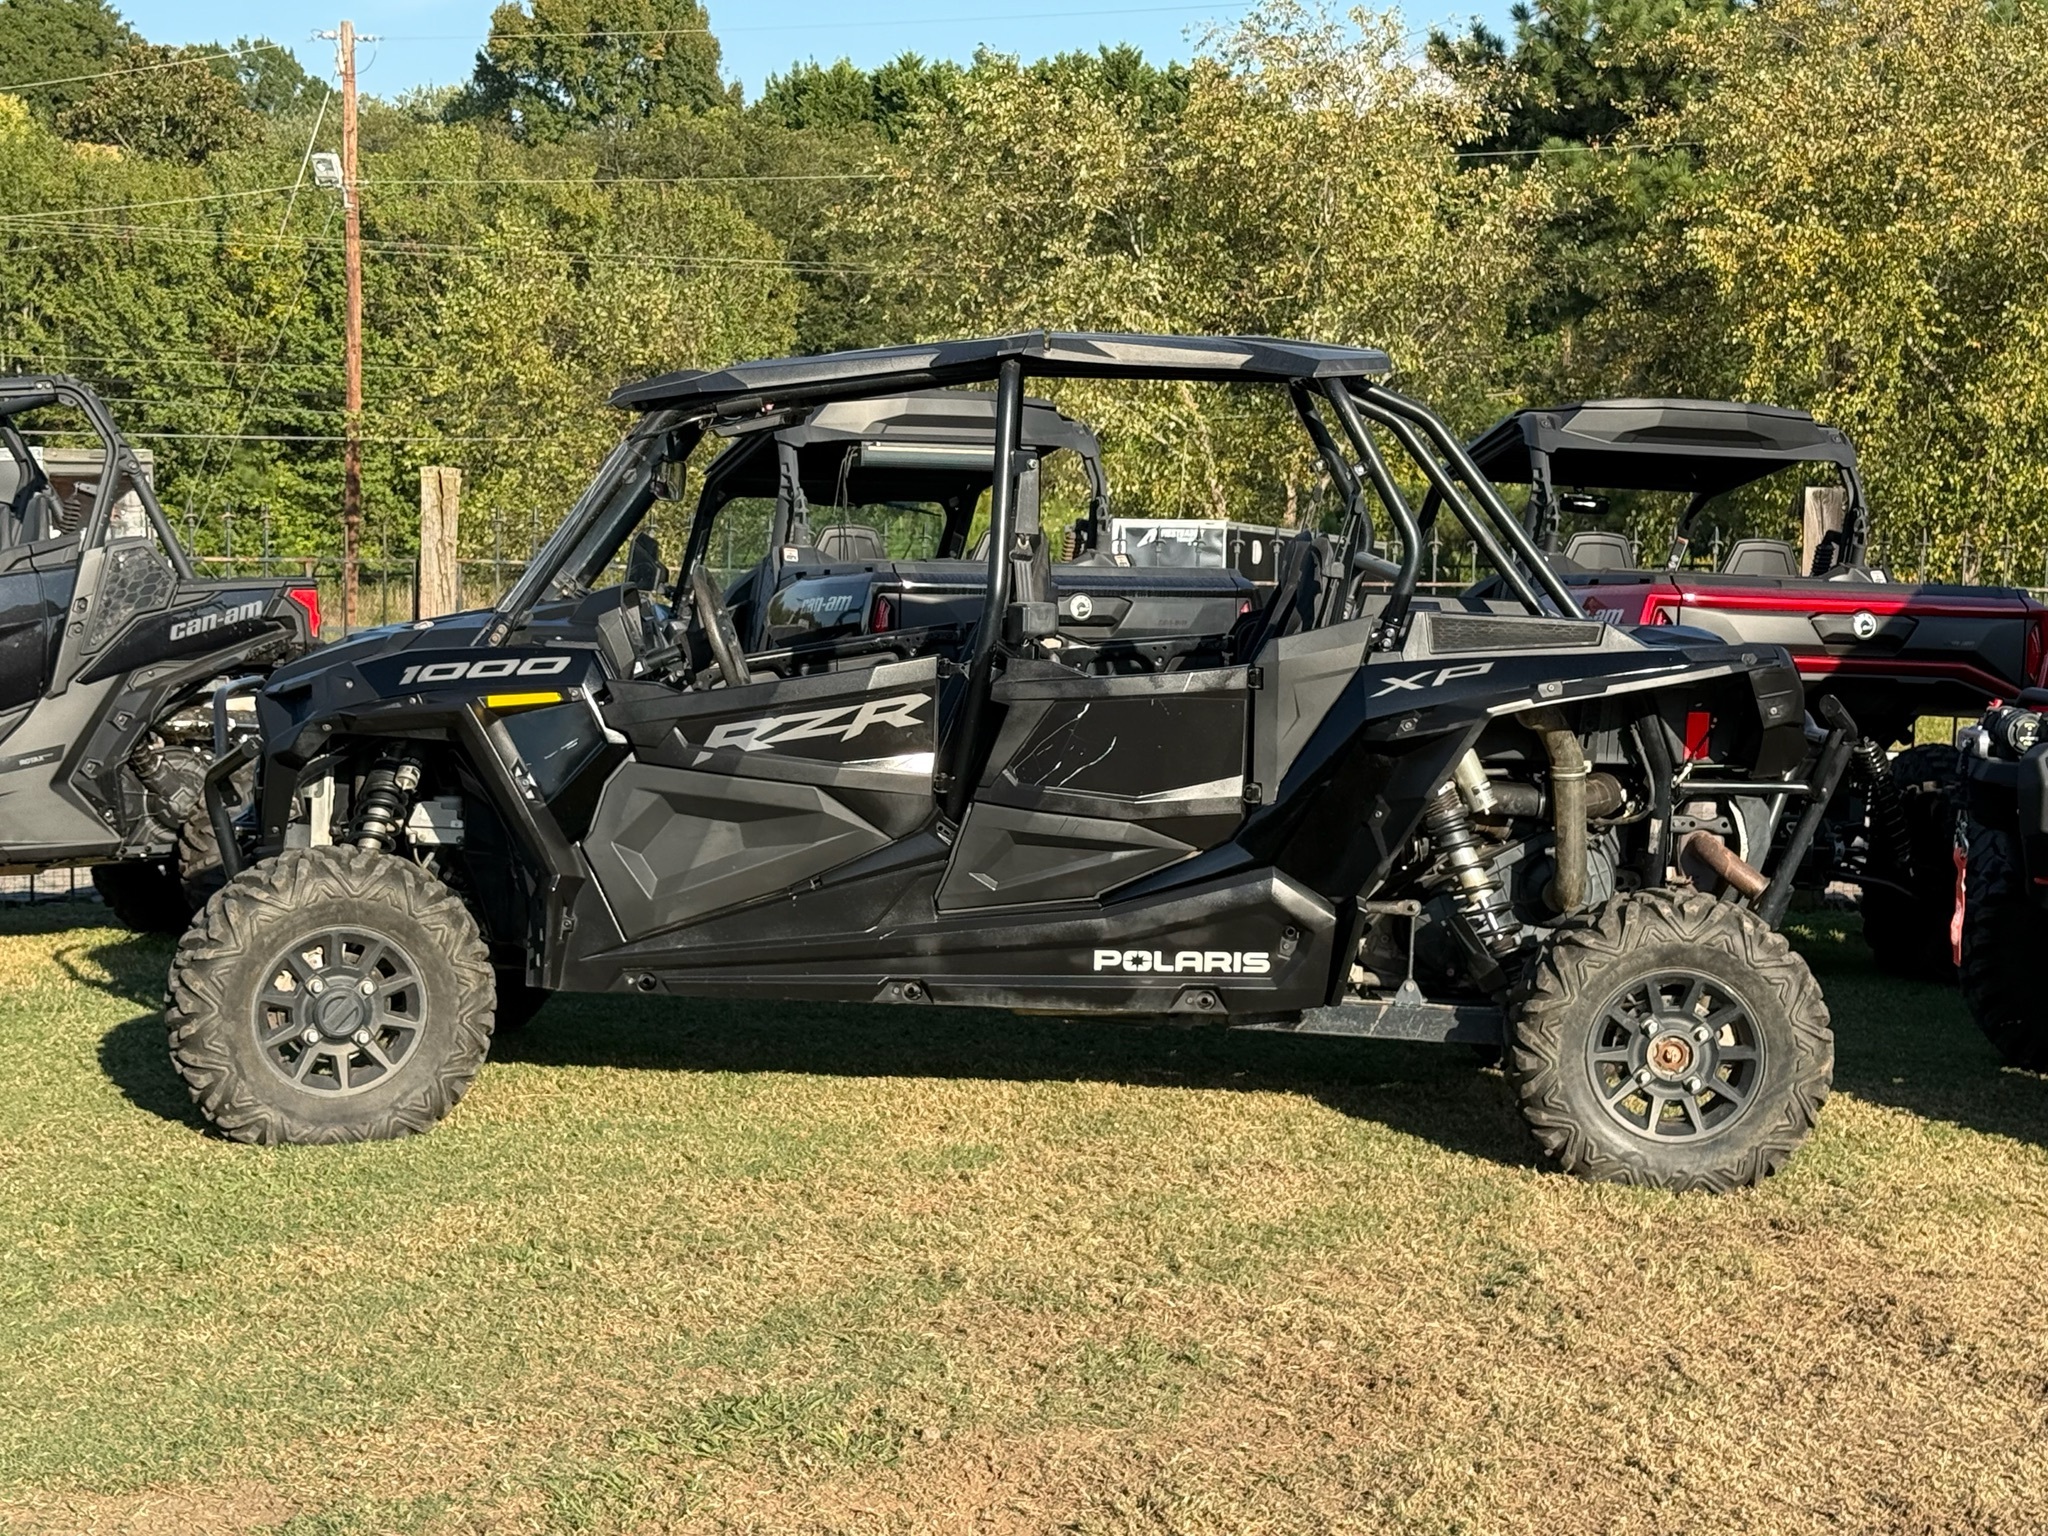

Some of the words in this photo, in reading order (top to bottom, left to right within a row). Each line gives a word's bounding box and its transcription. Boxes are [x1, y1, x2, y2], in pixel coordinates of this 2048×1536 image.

[169, 600, 263, 641] can-am
[800, 595, 852, 613] can-am
[399, 656, 572, 686] 1000
[1367, 661, 1495, 698] XP
[691, 692, 932, 767] RZR
[1093, 949, 1270, 973] POLARIS
